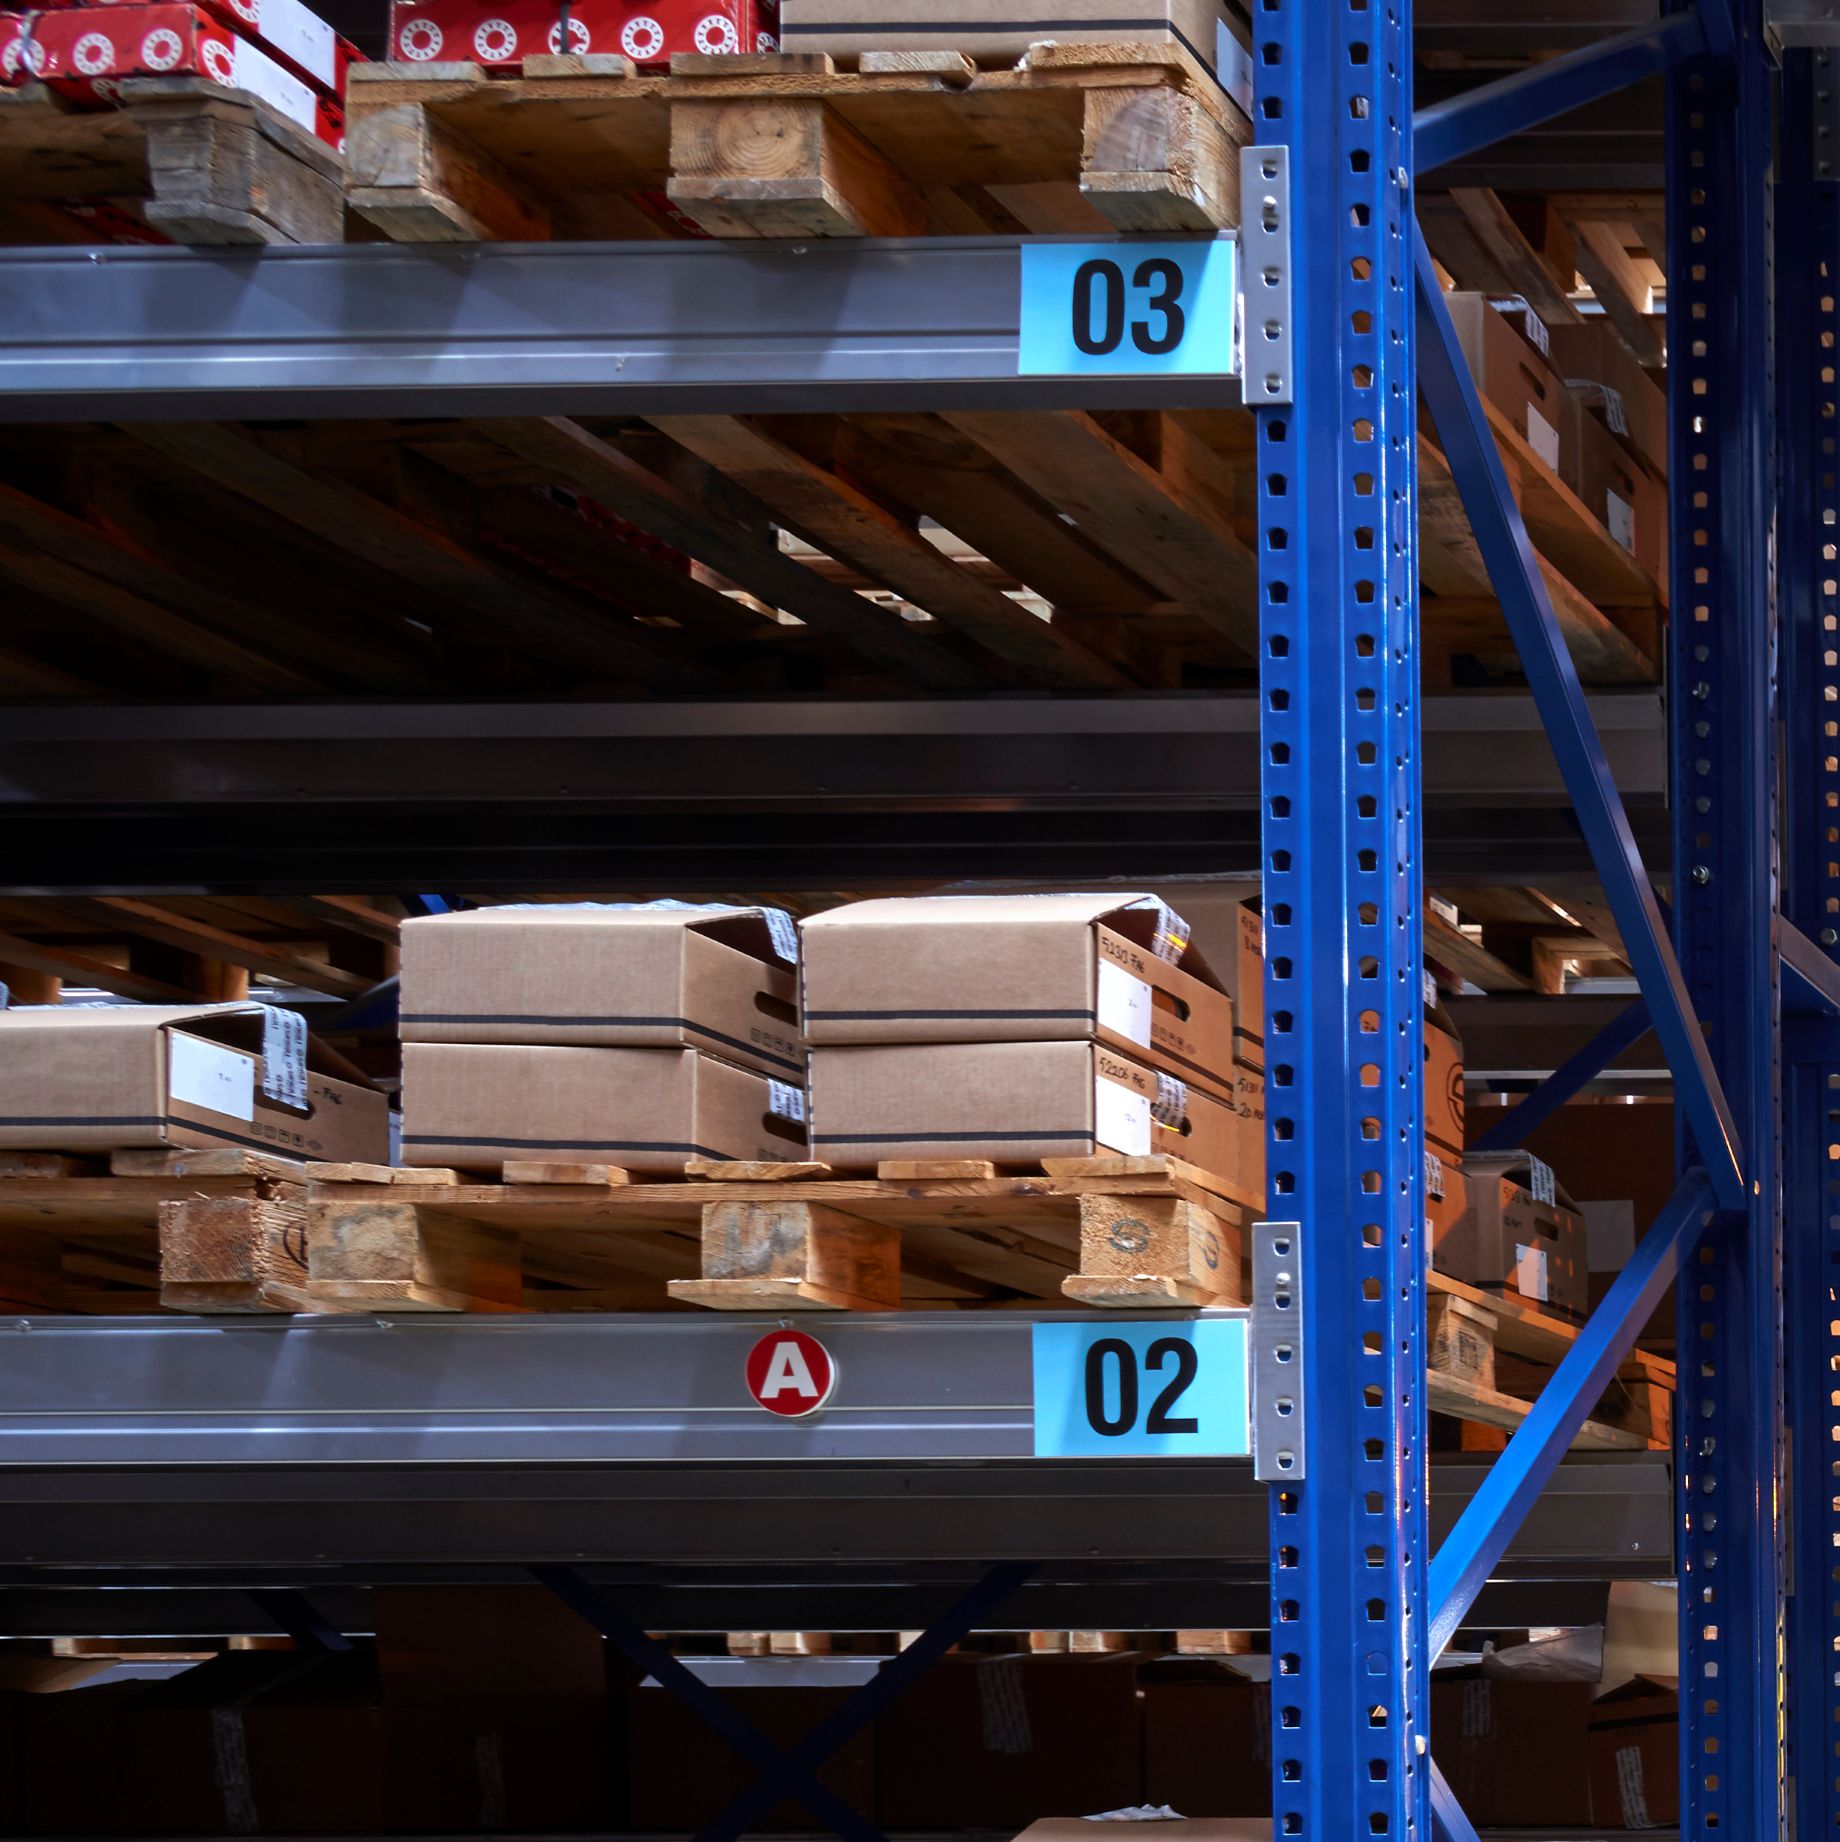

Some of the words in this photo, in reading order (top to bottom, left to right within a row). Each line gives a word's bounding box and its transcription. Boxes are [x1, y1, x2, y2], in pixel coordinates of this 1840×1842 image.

[1072, 258, 1185, 356] 03
[760, 1342, 818, 1399] A
[1085, 1337, 1199, 1437] 02
